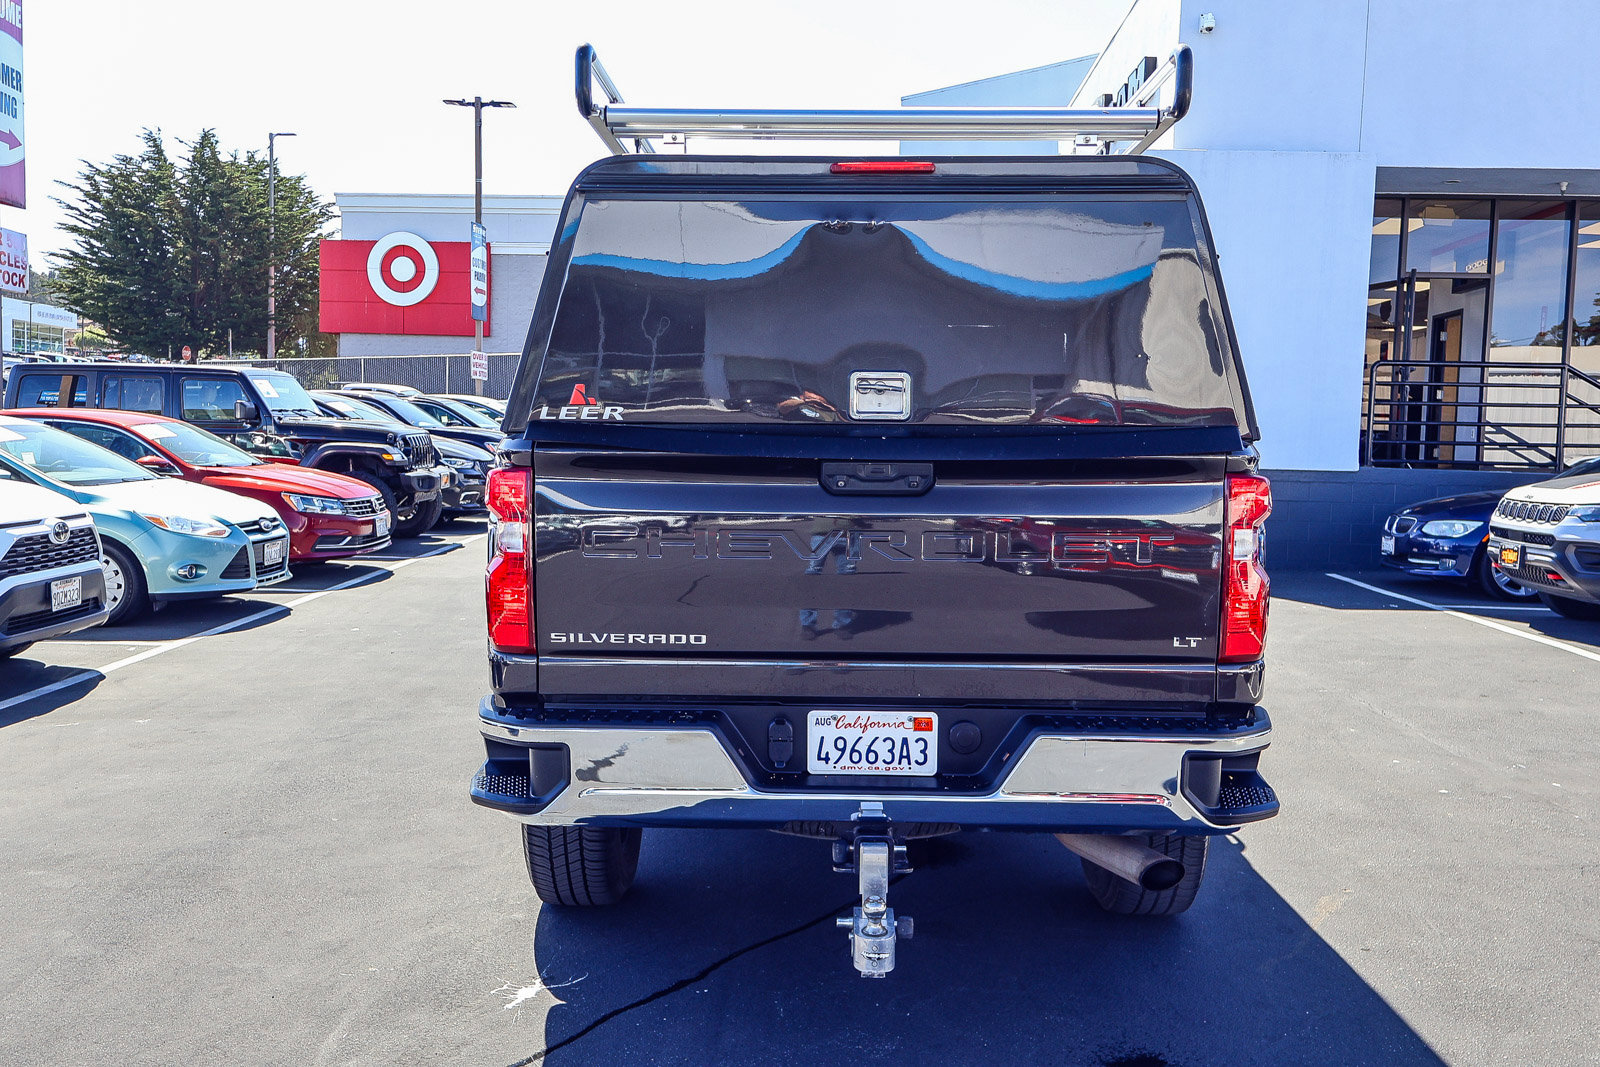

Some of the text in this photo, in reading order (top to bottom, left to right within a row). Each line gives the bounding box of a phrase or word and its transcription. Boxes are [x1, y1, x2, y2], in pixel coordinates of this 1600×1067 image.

[0, 62, 22, 93] MER
[540, 406, 624, 421] LEER
[582, 526, 1175, 563] CHEVROLET
[550, 632, 707, 645] SILVERADO
[1173, 636, 1202, 647] LT
[814, 717, 832, 727] AUG
[835, 714, 907, 733] California
[816, 735, 929, 767] 49663A3
